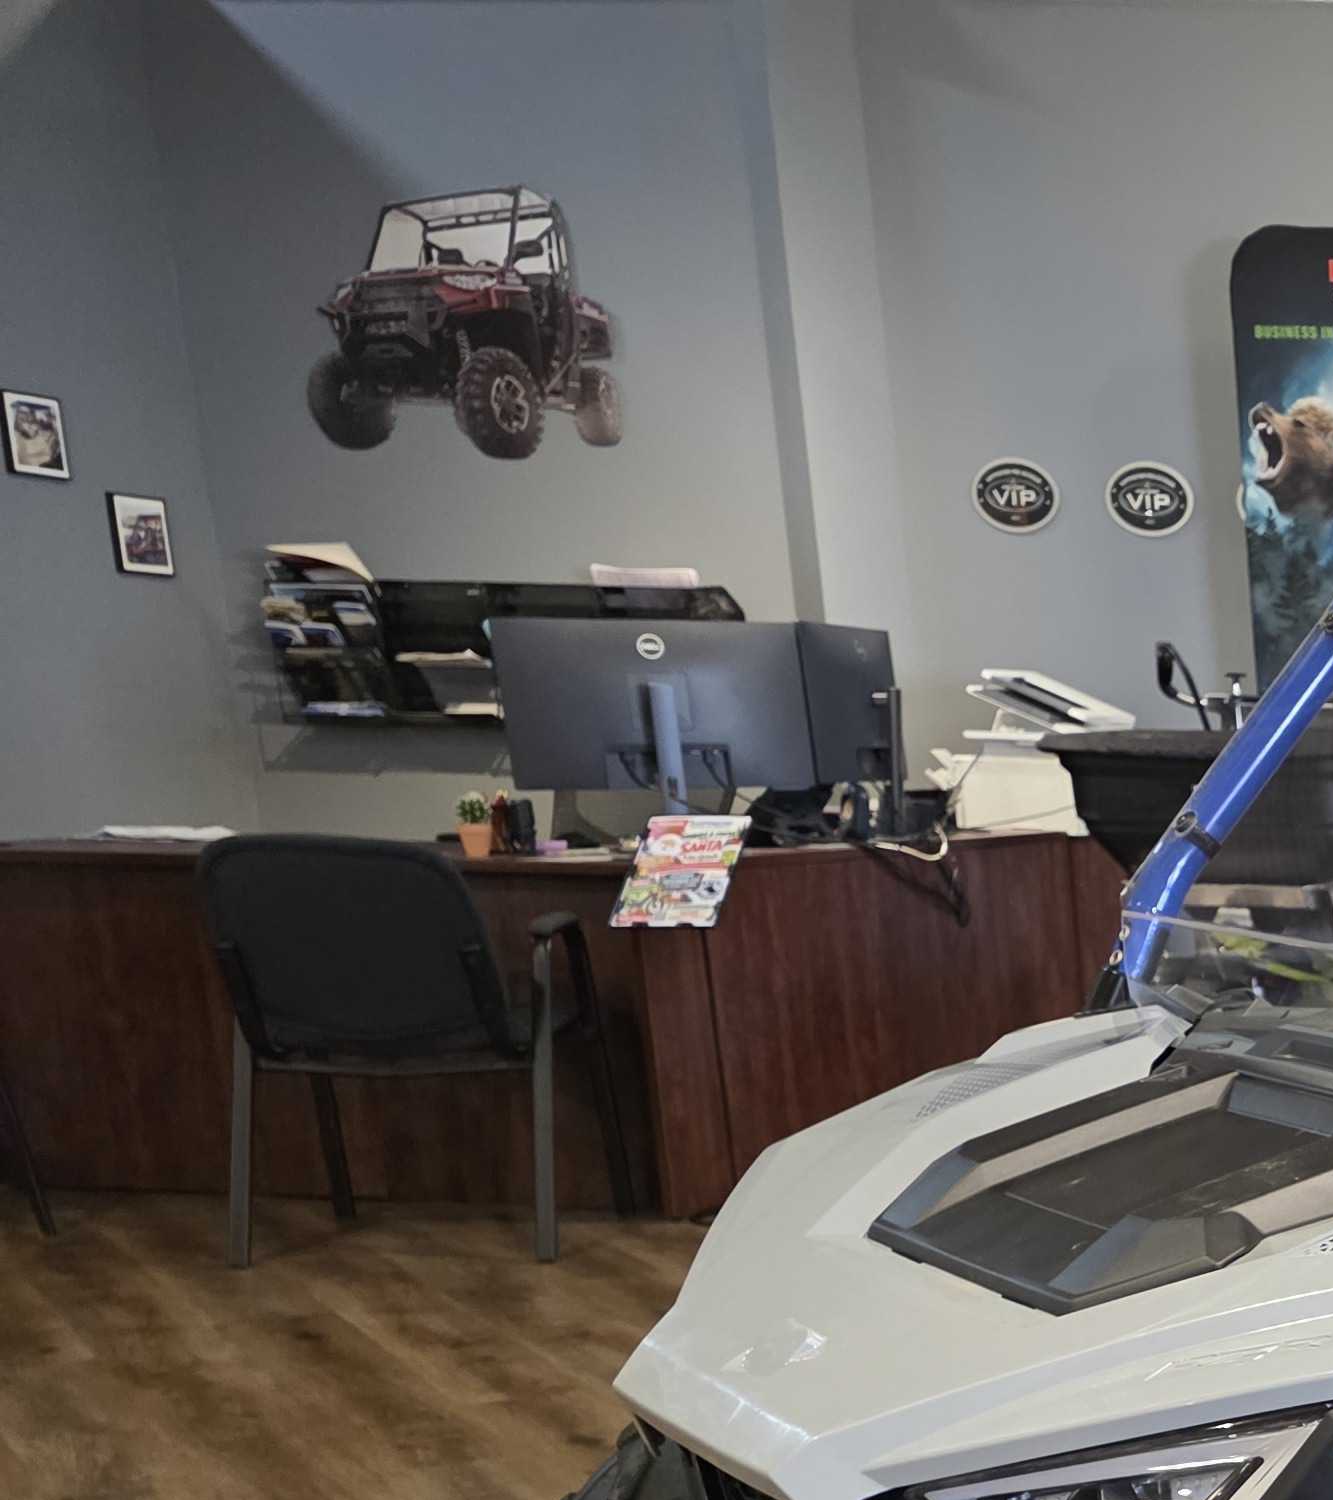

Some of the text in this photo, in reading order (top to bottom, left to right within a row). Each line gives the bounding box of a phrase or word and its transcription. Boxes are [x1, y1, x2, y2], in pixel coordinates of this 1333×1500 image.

[1254, 324, 1318, 339] BUSINESS
[992, 486, 1037, 507] VIP
[1125, 491, 1172, 512] VIP
